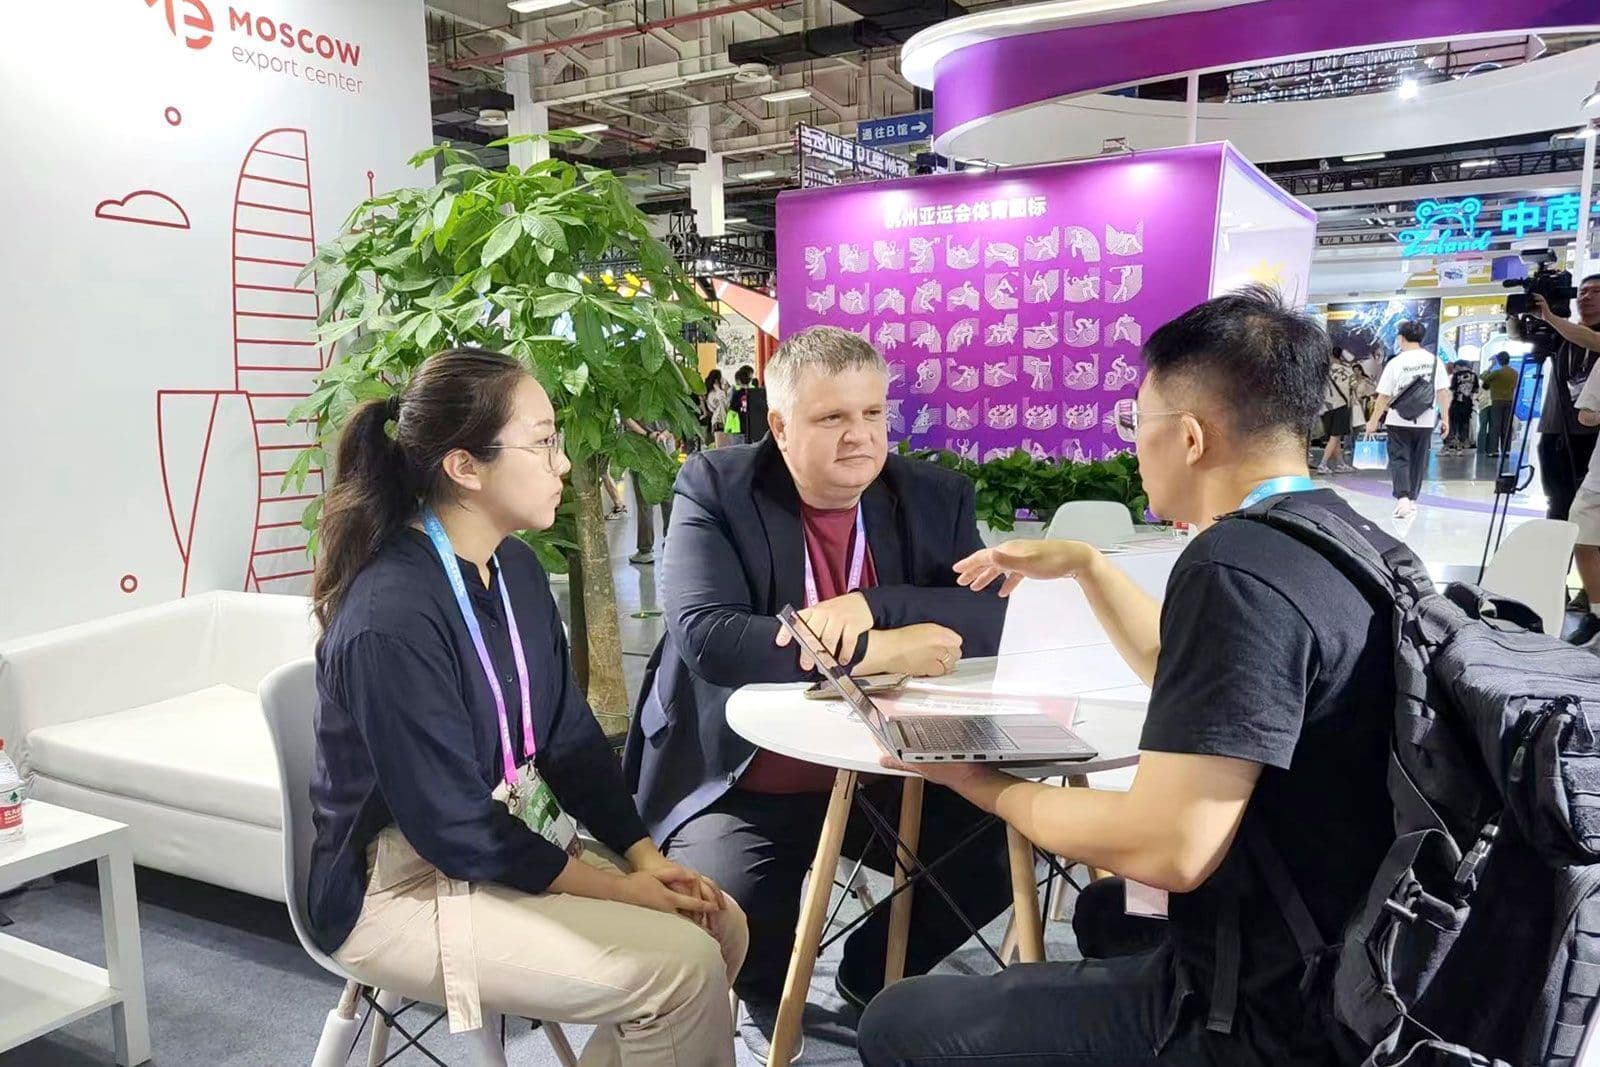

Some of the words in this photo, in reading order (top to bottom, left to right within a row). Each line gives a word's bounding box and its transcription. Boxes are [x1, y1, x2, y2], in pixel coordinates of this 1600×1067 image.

[228, 6, 360, 67] MOSCOW
[231, 45, 299, 77] export
[304, 65, 363, 94] center
